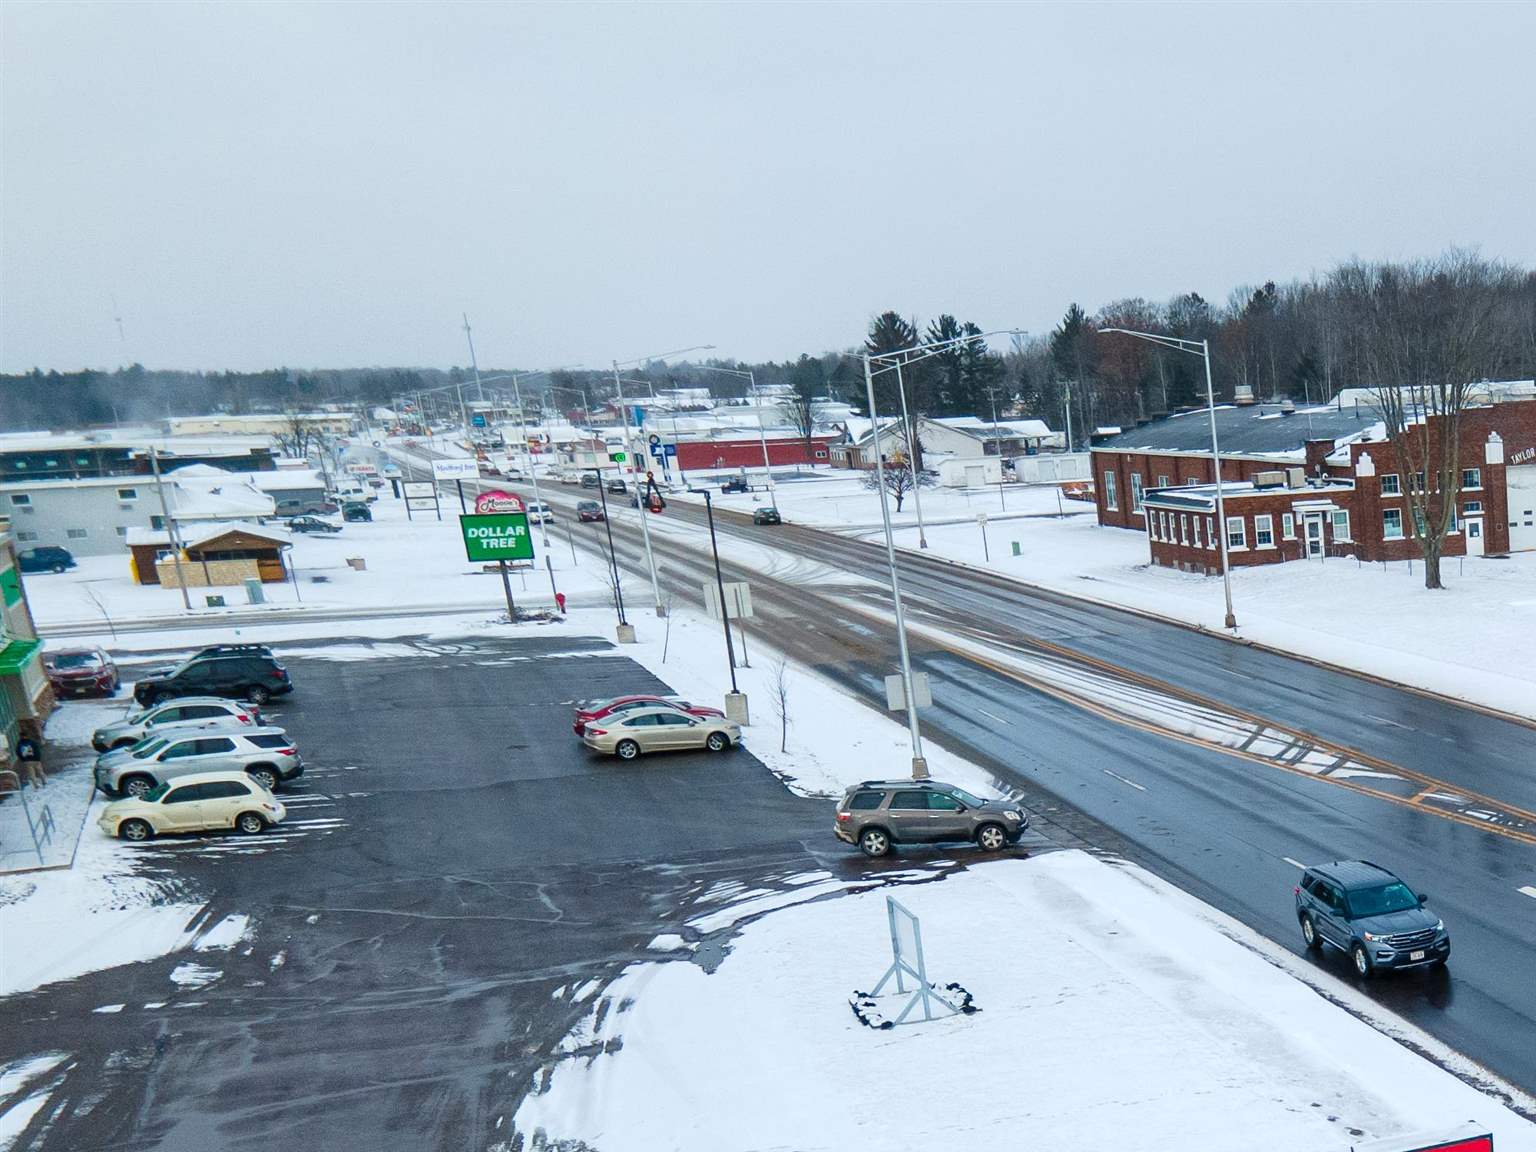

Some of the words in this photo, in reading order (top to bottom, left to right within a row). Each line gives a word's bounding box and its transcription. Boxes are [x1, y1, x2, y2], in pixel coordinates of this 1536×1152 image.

[1511, 447, 1536, 464] TAYLOR
[467, 526, 526, 538] DOLLAR
[480, 537, 516, 549] TREE
